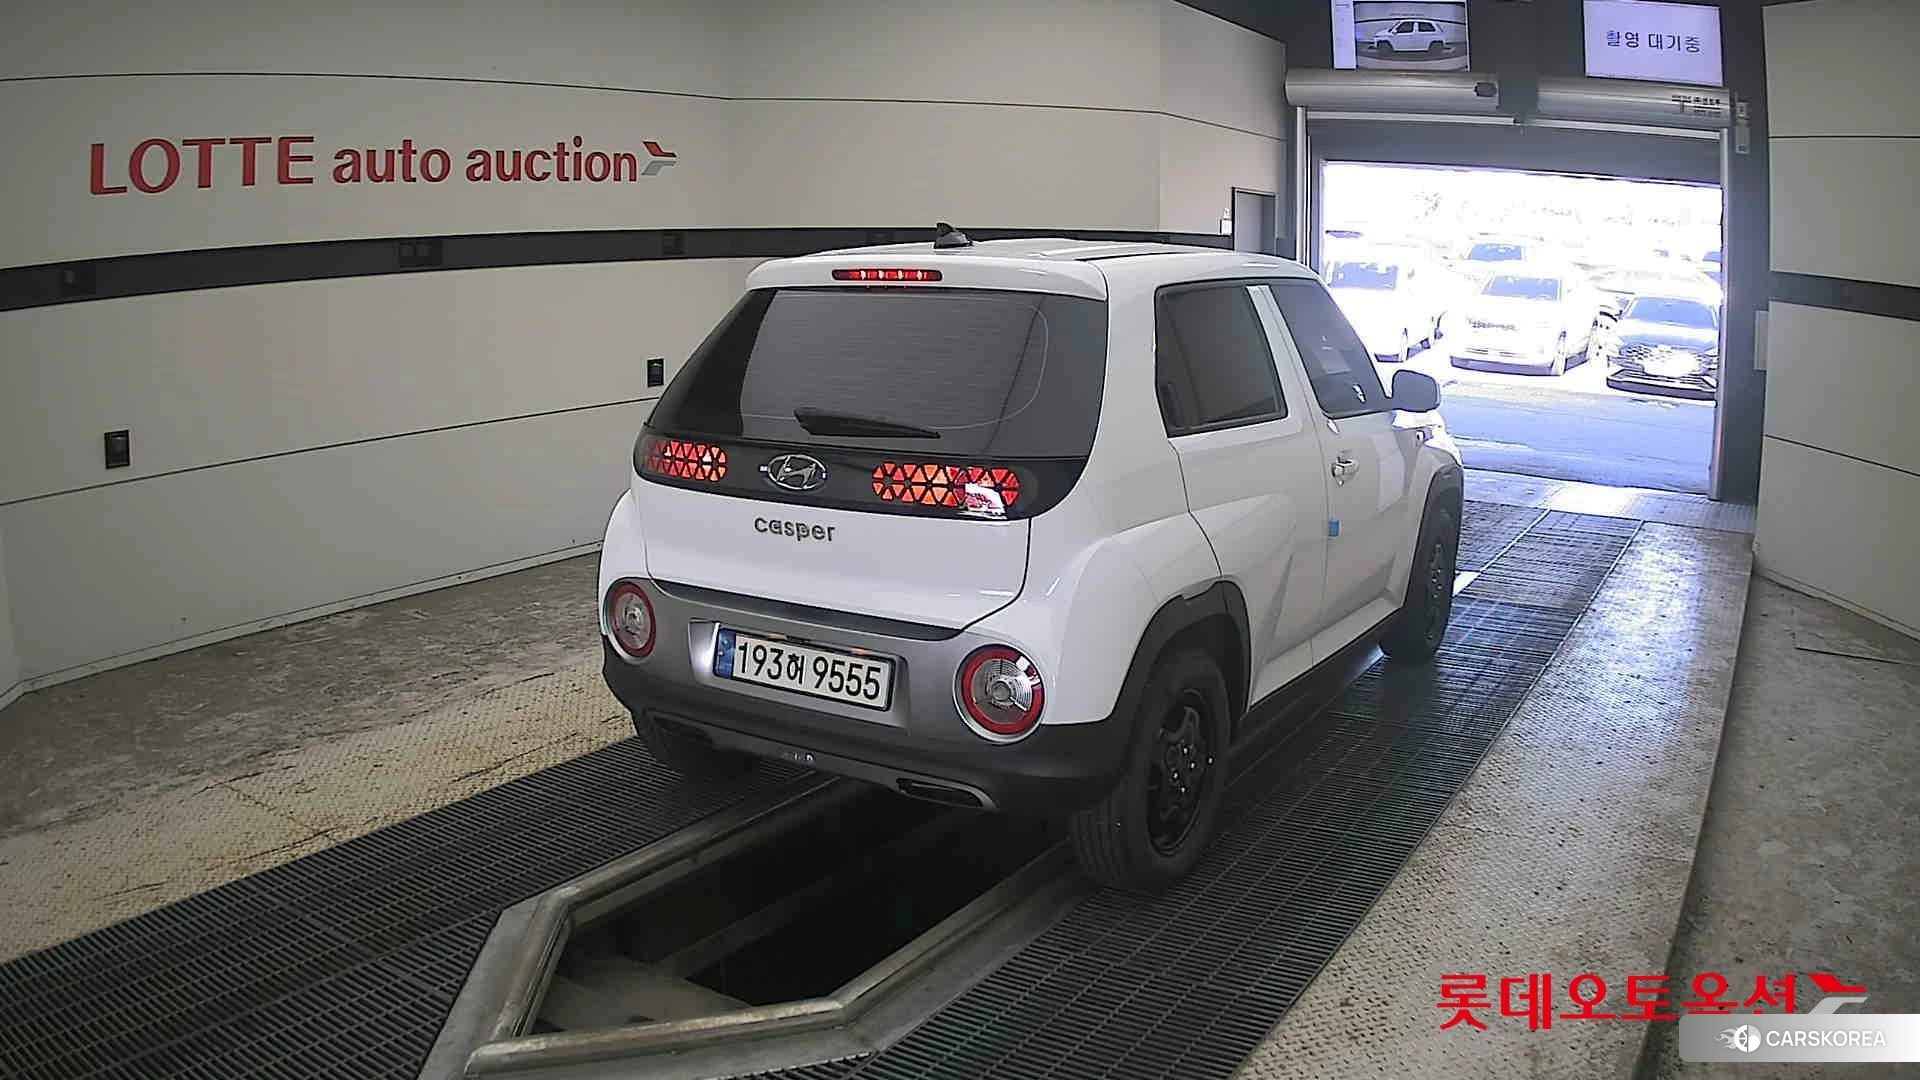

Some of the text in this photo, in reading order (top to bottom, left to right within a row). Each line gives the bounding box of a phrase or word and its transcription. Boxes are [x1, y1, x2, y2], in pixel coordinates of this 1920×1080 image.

[1647, 33, 1700, 53] 대기중
[90, 135, 638, 195] LOTTE auto auction
[754, 517, 836, 542] casper
[737, 641, 882, 701] 193허 9555
